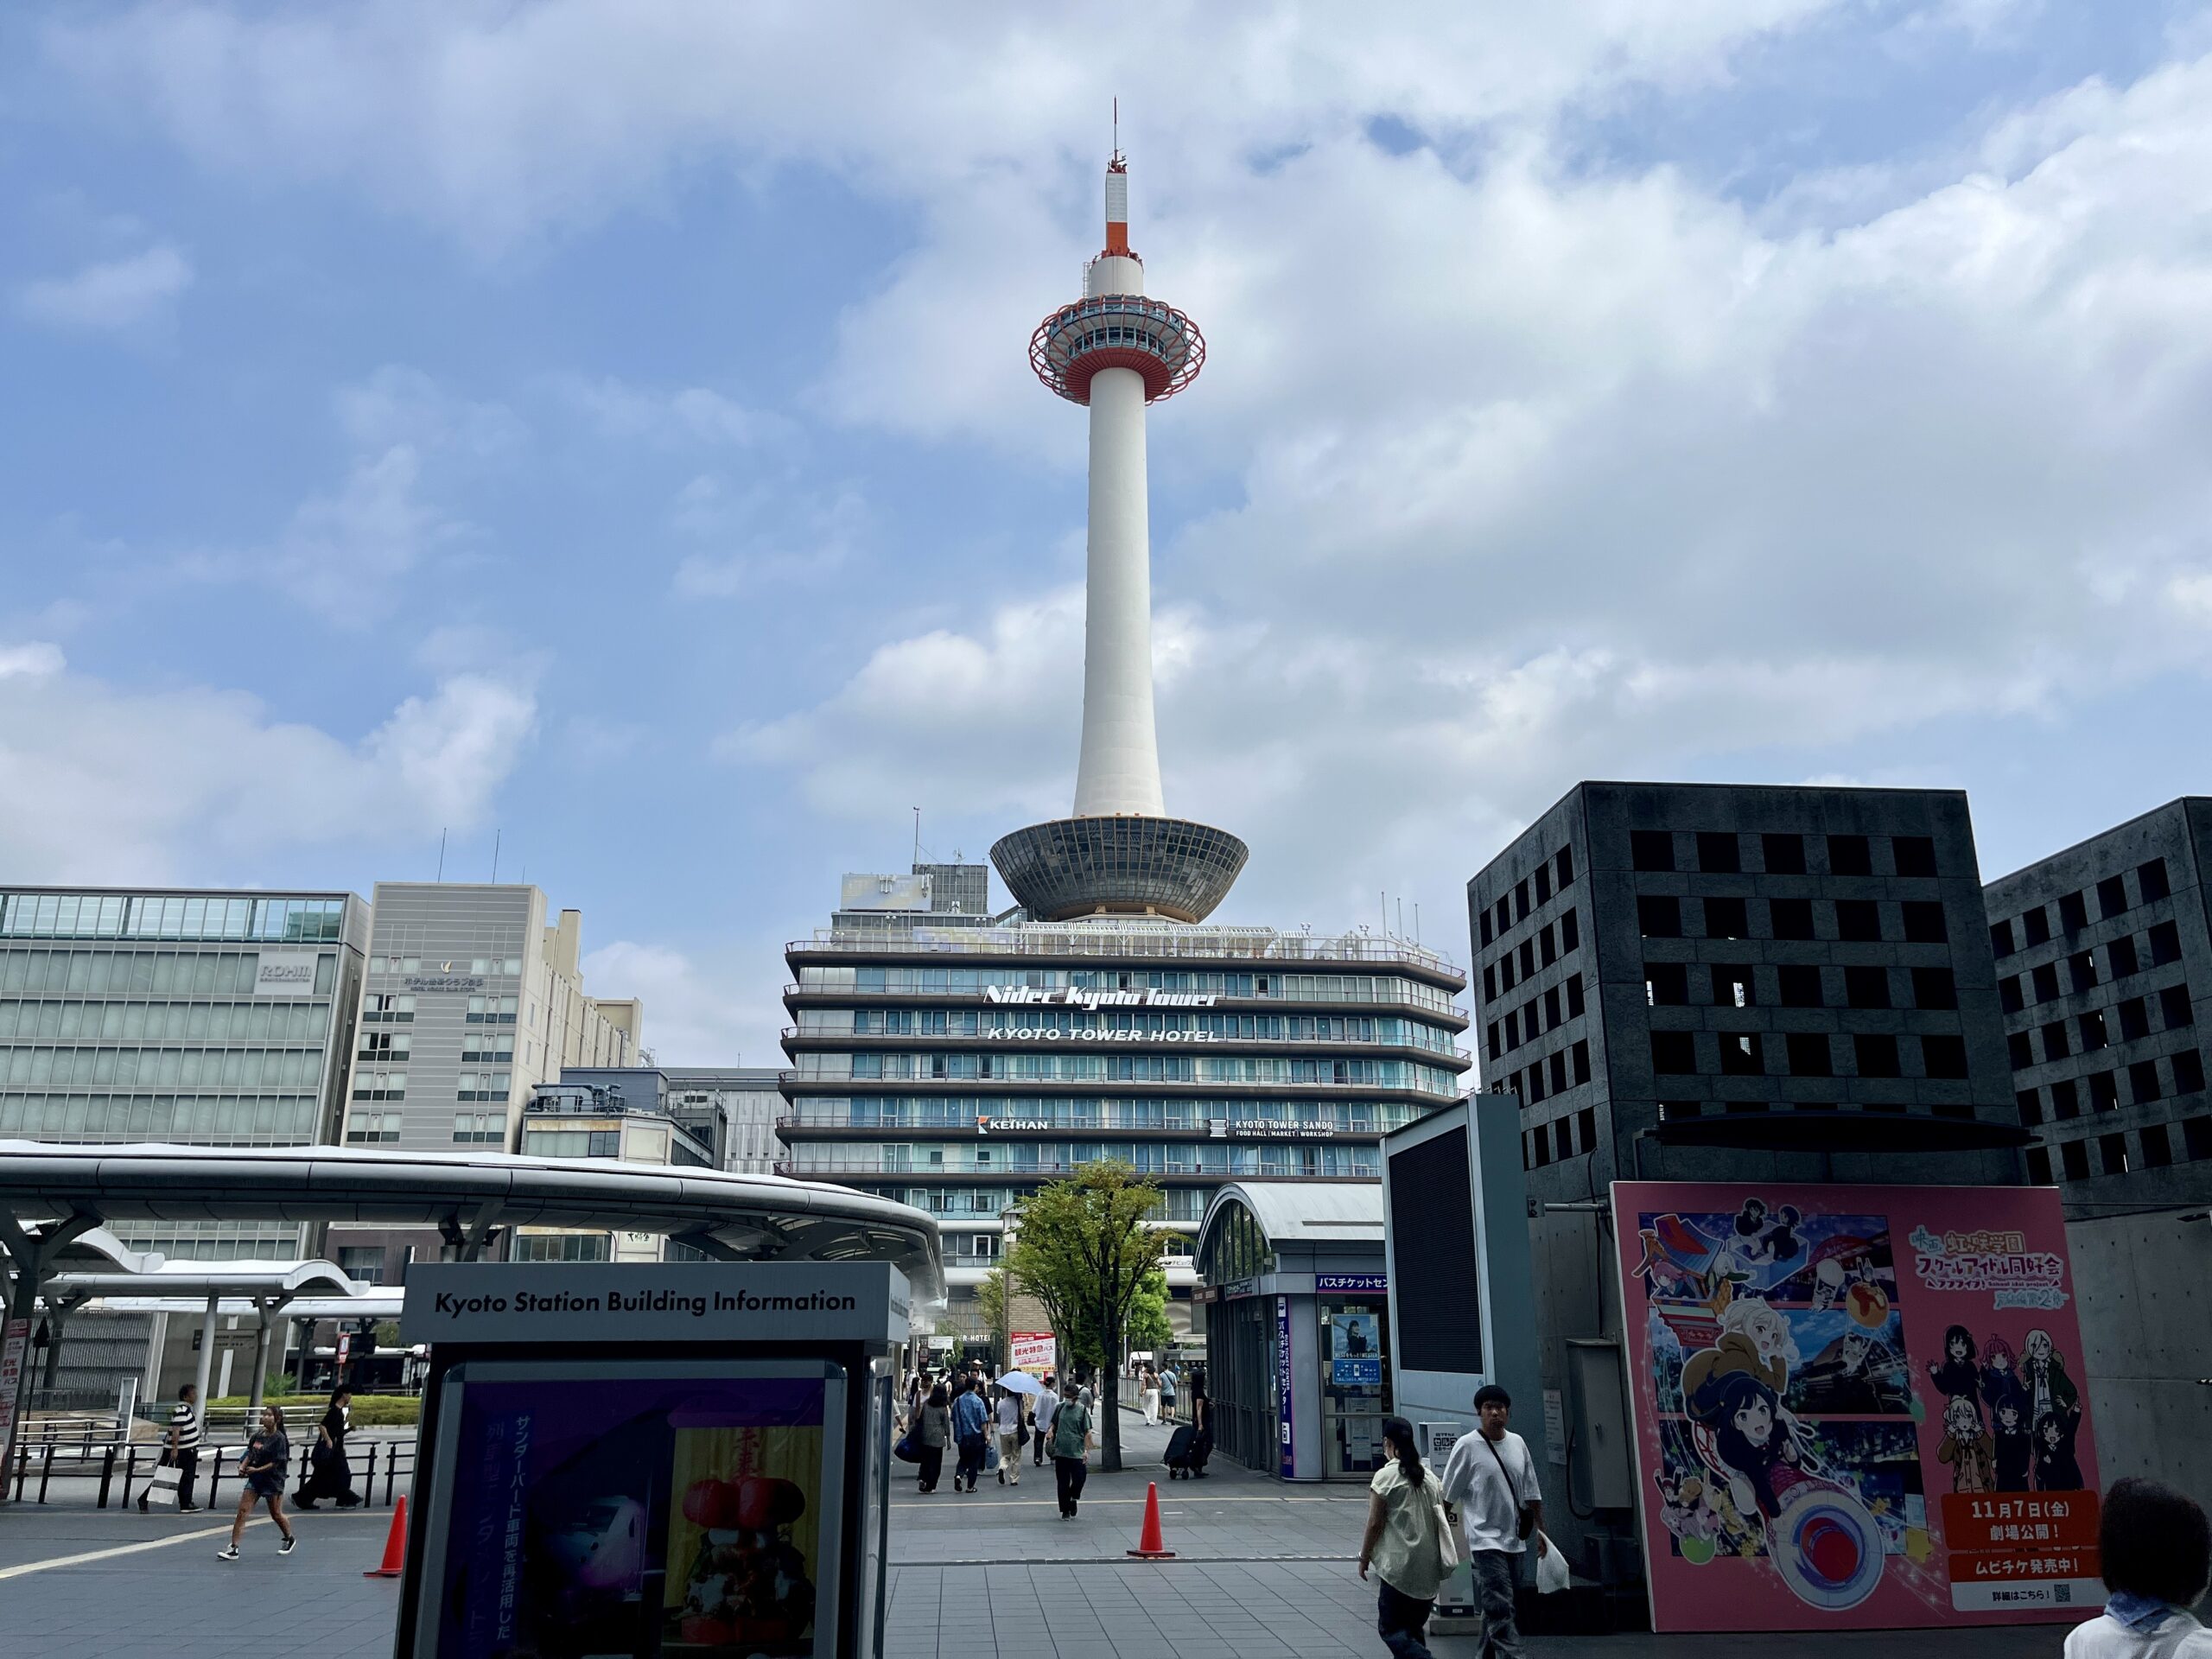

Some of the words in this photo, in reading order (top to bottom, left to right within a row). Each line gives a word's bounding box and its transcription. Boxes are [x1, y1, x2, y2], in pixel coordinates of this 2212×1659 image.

[260, 965, 312, 977] ROHM
[983, 985, 1062, 1004] Nidec
[1065, 986, 1141, 1010] Kyoto
[1144, 988, 1222, 1007] Tower
[988, 1027, 1061, 1040] KYOTO
[1069, 1029, 1142, 1041] TOWER
[1150, 1030, 1218, 1043] HOTEL
[990, 1119, 1048, 1130] KEIHAN
[1236, 1120, 1265, 1128] KYOTO
[1268, 1121, 1300, 1129] TOWER
[1303, 1121, 1333, 1130] SANDO
[1911, 1228, 1942, 1252] 映画
[1917, 1255, 2061, 1275] スクールアイドル同好会
[435, 1292, 508, 1319] Kyoto
[513, 1291, 601, 1313] Station
[607, 1290, 707, 1317] Building
[713, 1289, 856, 1312] Information
[1971, 1499, 2069, 1519] 11月7日(金)
[495, 1414, 533, 1640] サンダーバード車両を再活用した
[1990, 1522, 2059, 1541] 劇場公開!
[1975, 1557, 2079, 1575] ムビチケ発売中!
[1992, 1589, 2050, 1602] 詳細はこちら!
